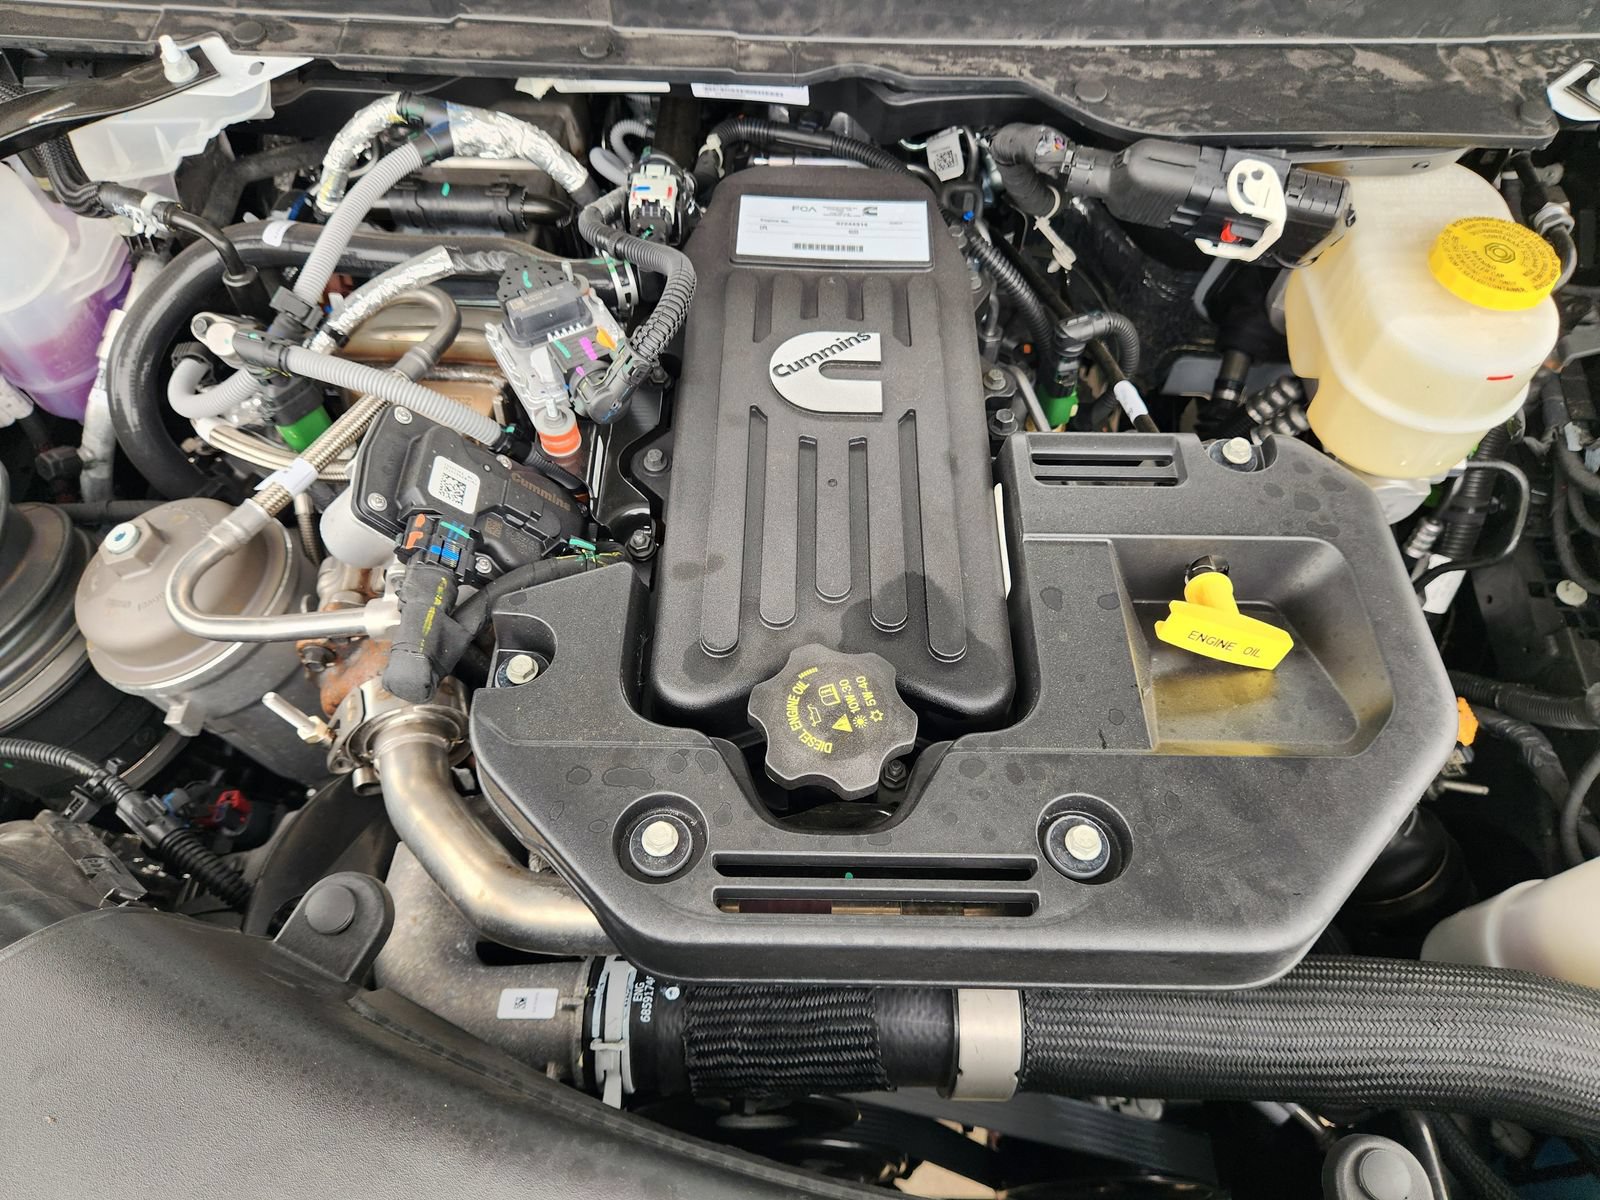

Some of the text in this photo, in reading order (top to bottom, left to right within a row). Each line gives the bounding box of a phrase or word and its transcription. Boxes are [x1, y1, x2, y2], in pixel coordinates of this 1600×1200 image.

[772, 332, 872, 377] Cummins
[511, 471, 571, 511] Cummins
[1187, 630, 1261, 658] ENGINE OIL
[839, 679, 861, 714] 10W-30
[855, 675, 877, 707] 5W-40
[786, 681, 833, 754] DIESEL ENGINE OIL
[632, 981, 646, 1002] ENG
